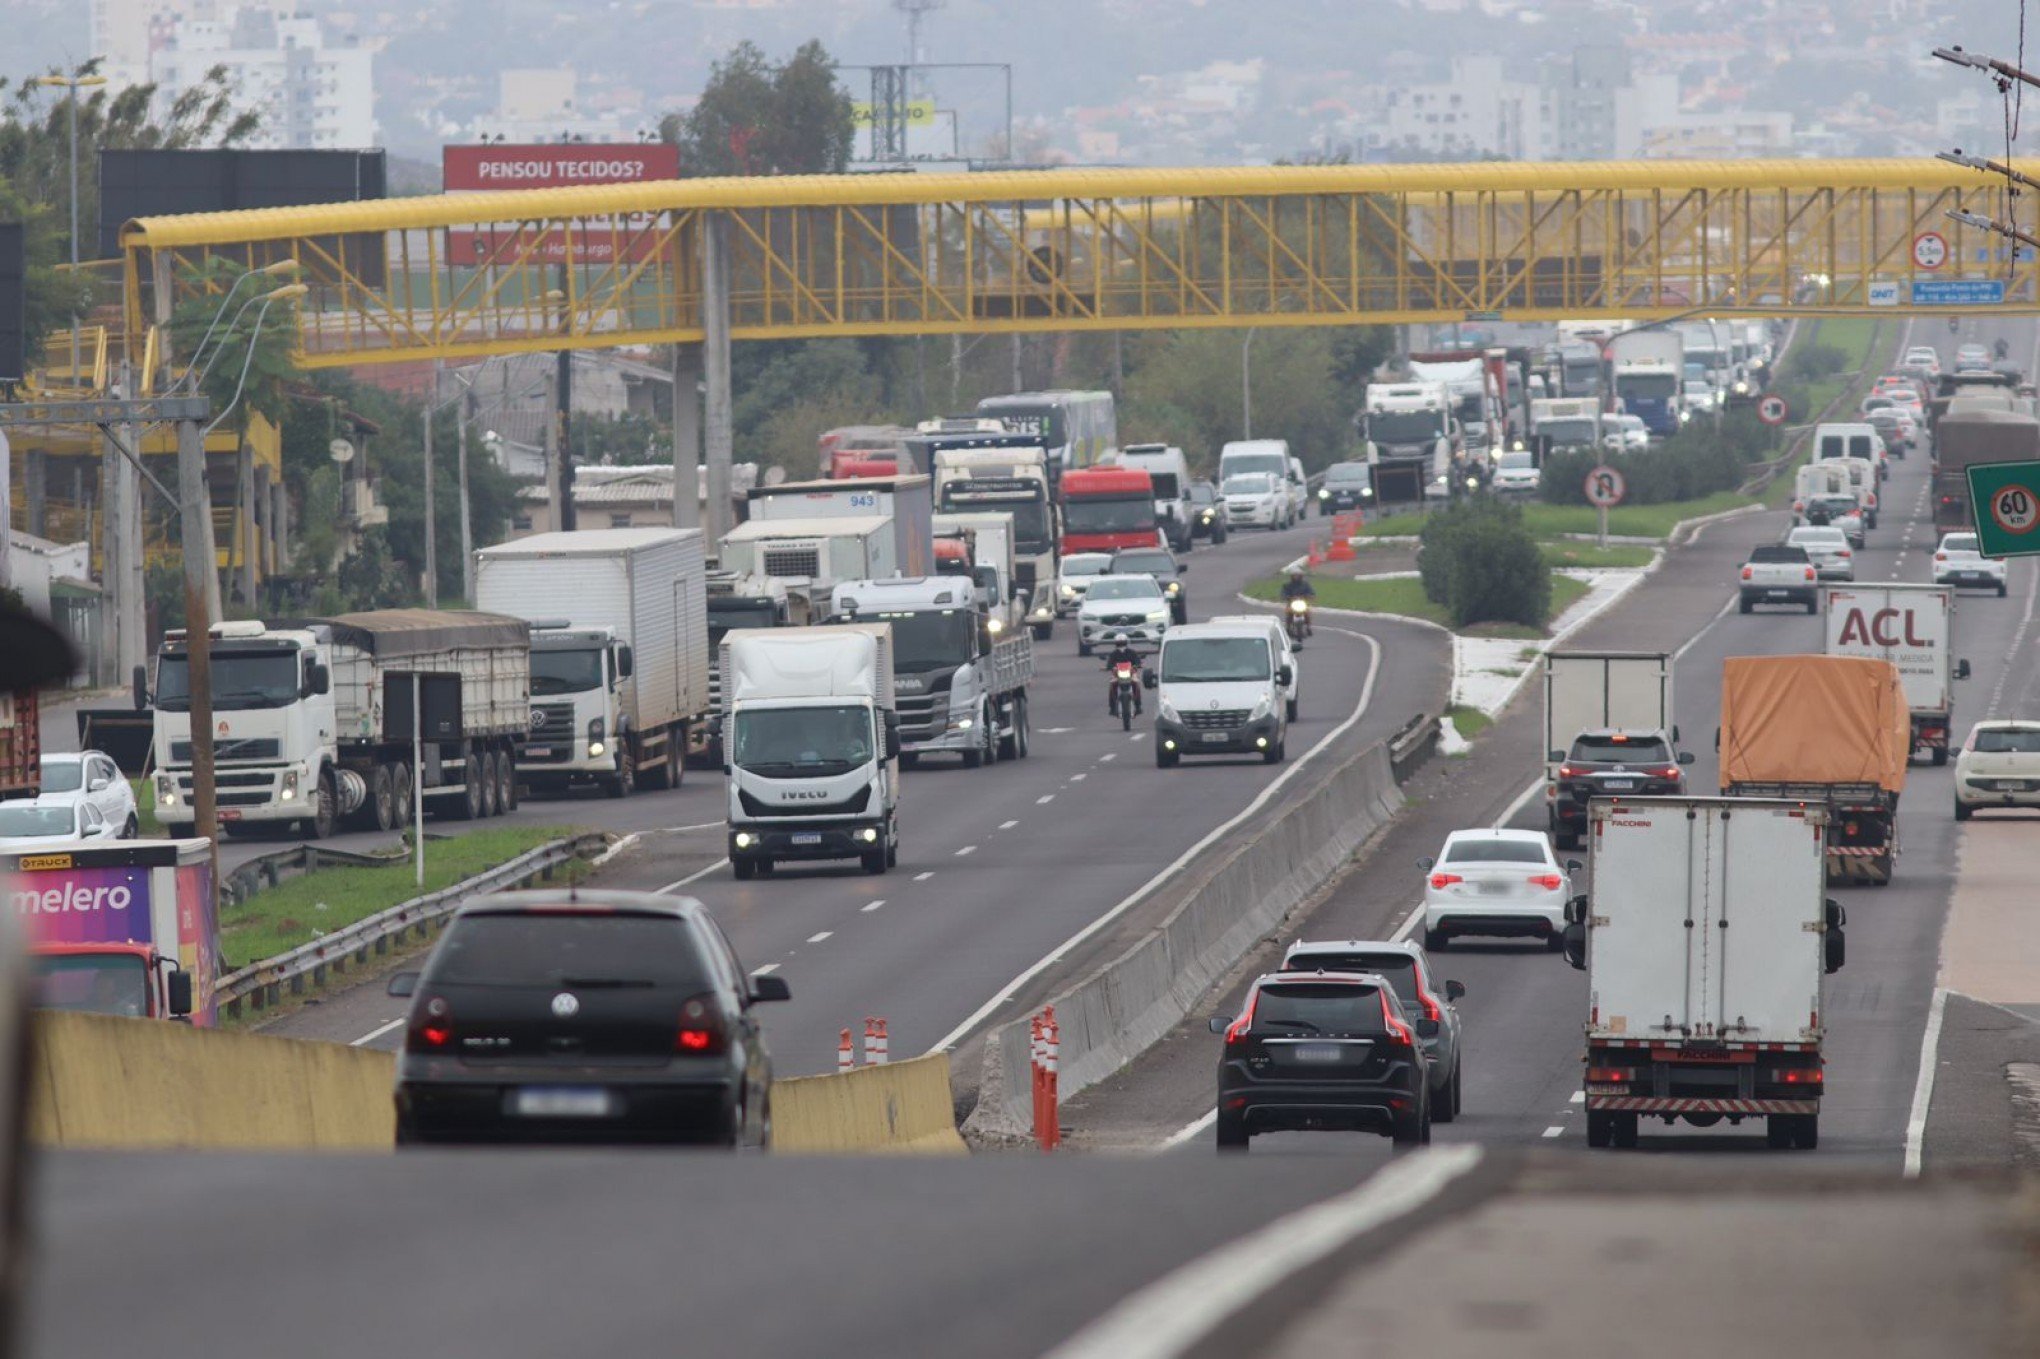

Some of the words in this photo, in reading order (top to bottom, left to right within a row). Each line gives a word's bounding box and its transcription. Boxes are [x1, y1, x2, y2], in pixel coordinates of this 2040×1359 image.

[478, 161, 551, 179] PENSOU
[555, 160, 645, 178] TECIDOS?
[850, 495, 875, 506] 943
[2001, 491, 2028, 515] 60
[2010, 515, 2026, 524] km
[781, 790, 828, 799] IVECO
[1612, 820, 1652, 828] FACCHINI
